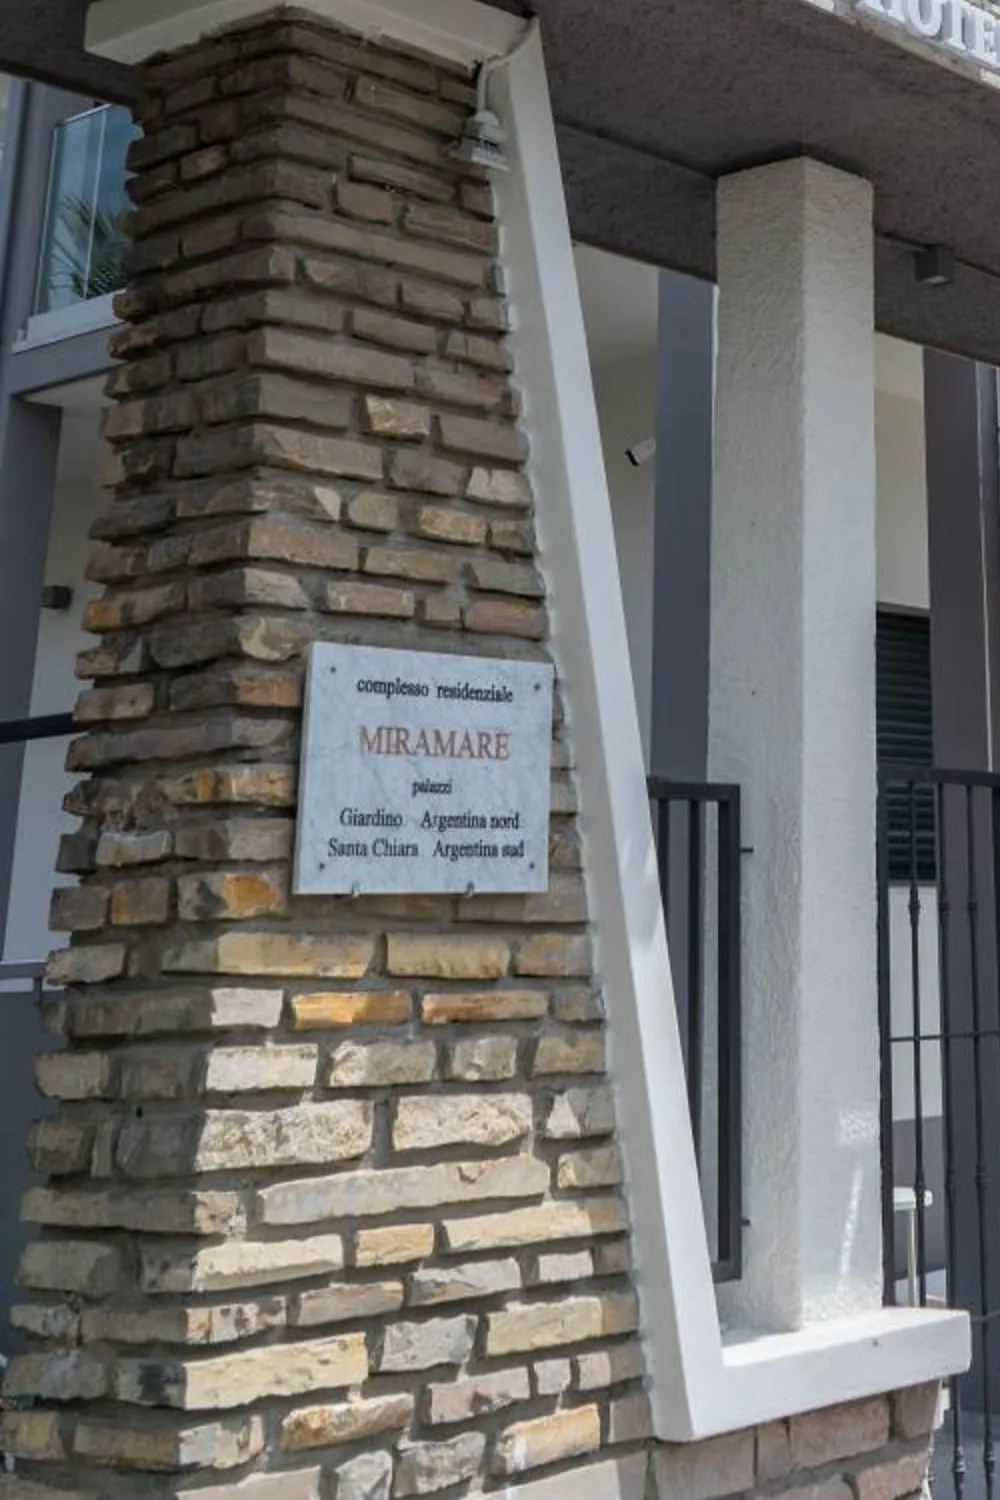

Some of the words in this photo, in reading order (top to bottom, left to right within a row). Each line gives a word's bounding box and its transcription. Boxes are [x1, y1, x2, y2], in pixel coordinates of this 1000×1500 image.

[357, 677, 429, 700] complesso
[436, 680, 514, 703] residenziale
[359, 725, 511, 761] MIRAMARE
[412, 778, 453, 797] palazzi
[339, 807, 403, 828] Giardino
[420, 809, 487, 831] Argentina
[489, 811, 519, 830] nord
[327, 838, 368, 857] Santa
[371, 840, 419, 857] Chiara
[432, 839, 498, 861] Argentina
[501, 840, 525, 858] sud
